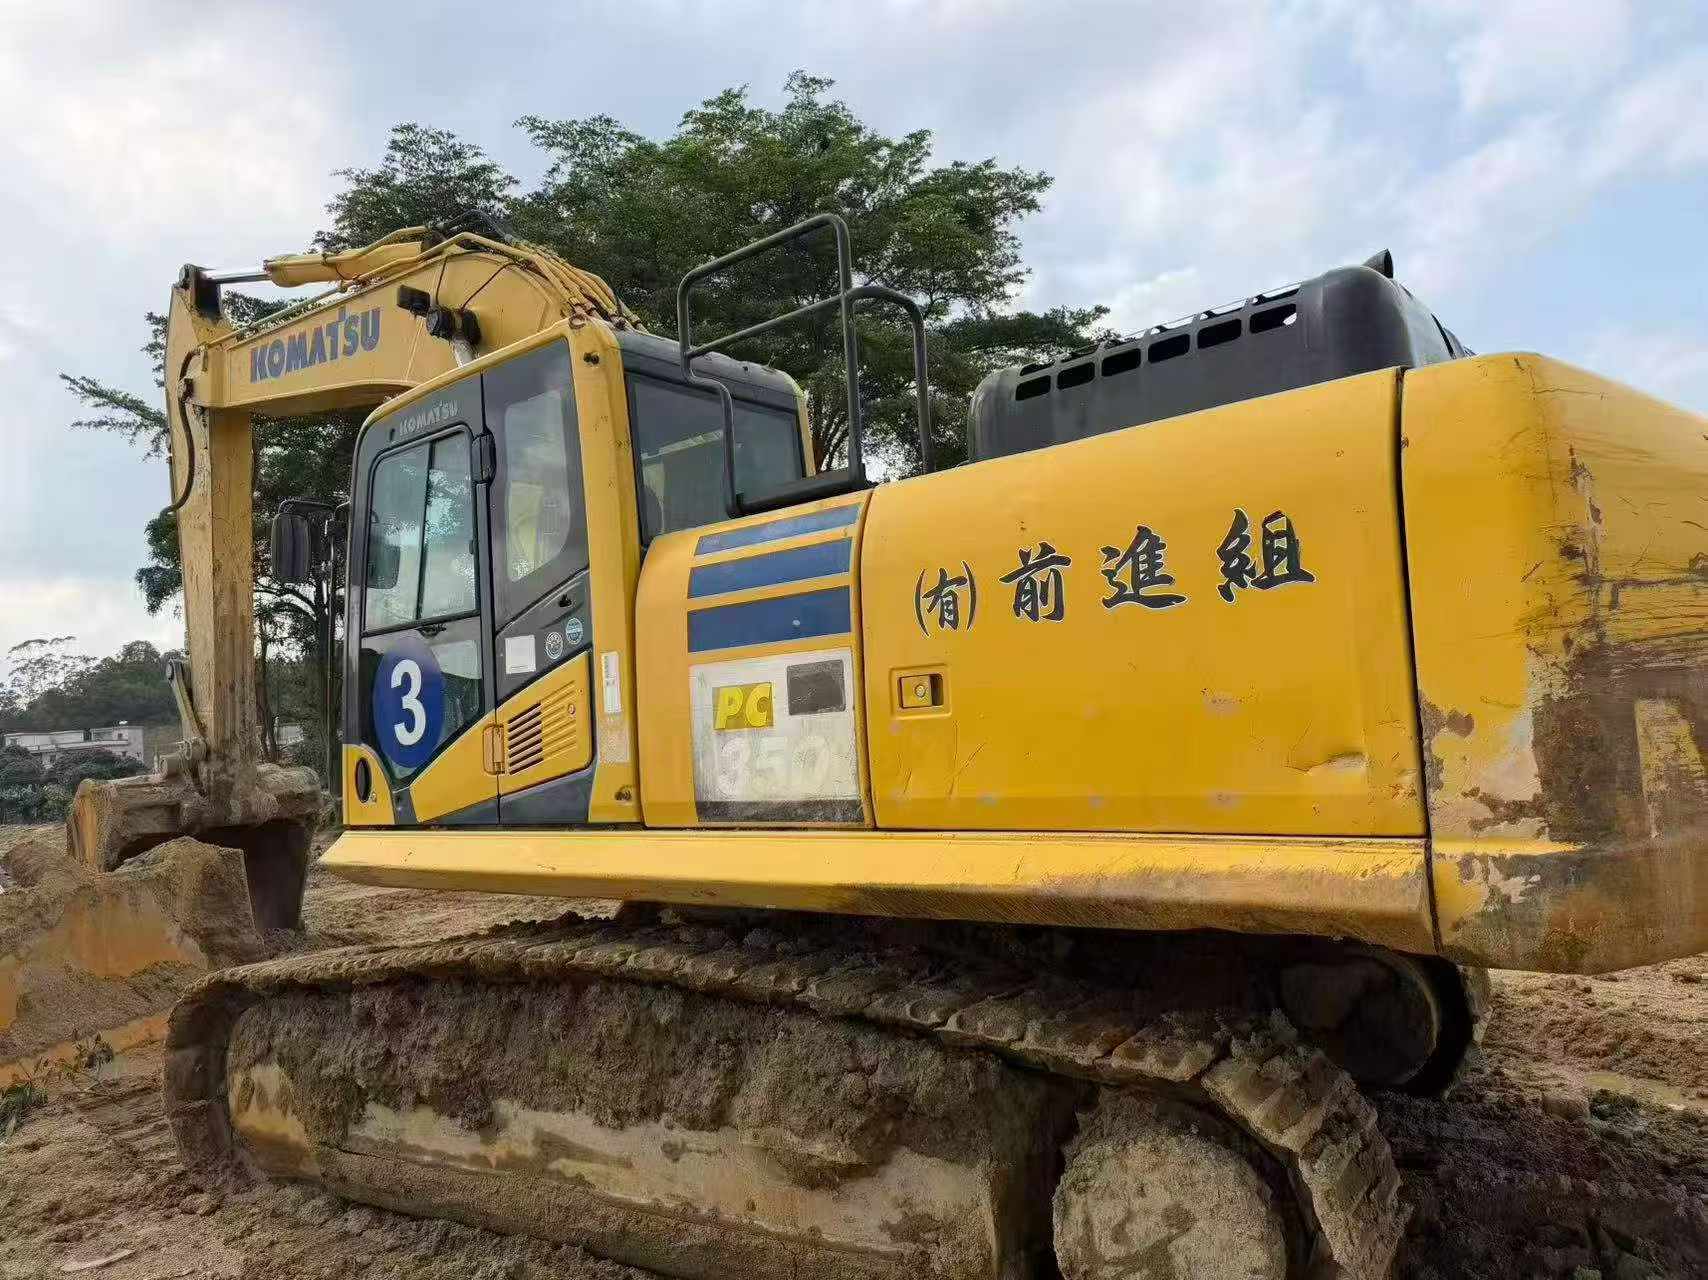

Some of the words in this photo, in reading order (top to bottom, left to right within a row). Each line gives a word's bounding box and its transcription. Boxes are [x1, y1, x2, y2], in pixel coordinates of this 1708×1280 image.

[251, 305, 382, 384] KOMATSU
[400, 400, 460, 434] KOMATSU
[391, 659, 426, 746] 3
[715, 683, 772, 730] PC
[717, 734, 830, 796] 350
